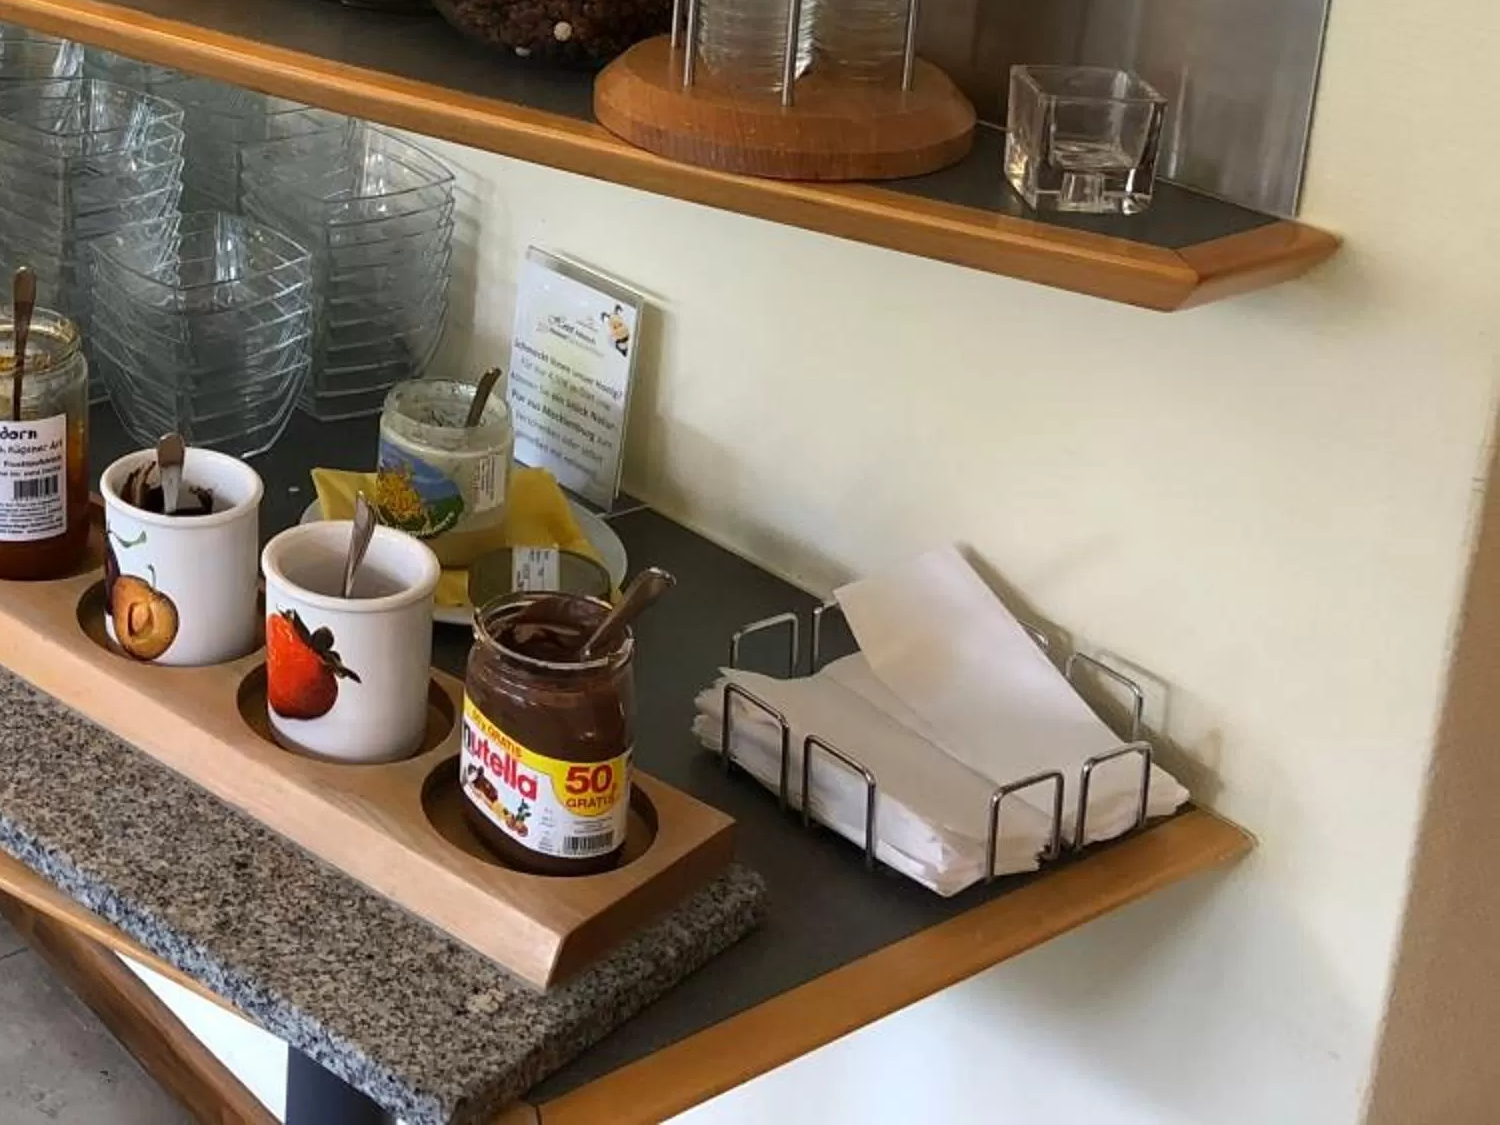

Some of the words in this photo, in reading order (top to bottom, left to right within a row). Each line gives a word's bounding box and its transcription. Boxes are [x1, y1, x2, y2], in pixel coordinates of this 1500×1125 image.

[463, 720, 537, 802] nutella
[564, 764, 613, 796] 50
[564, 796, 616, 809] GRATIS
